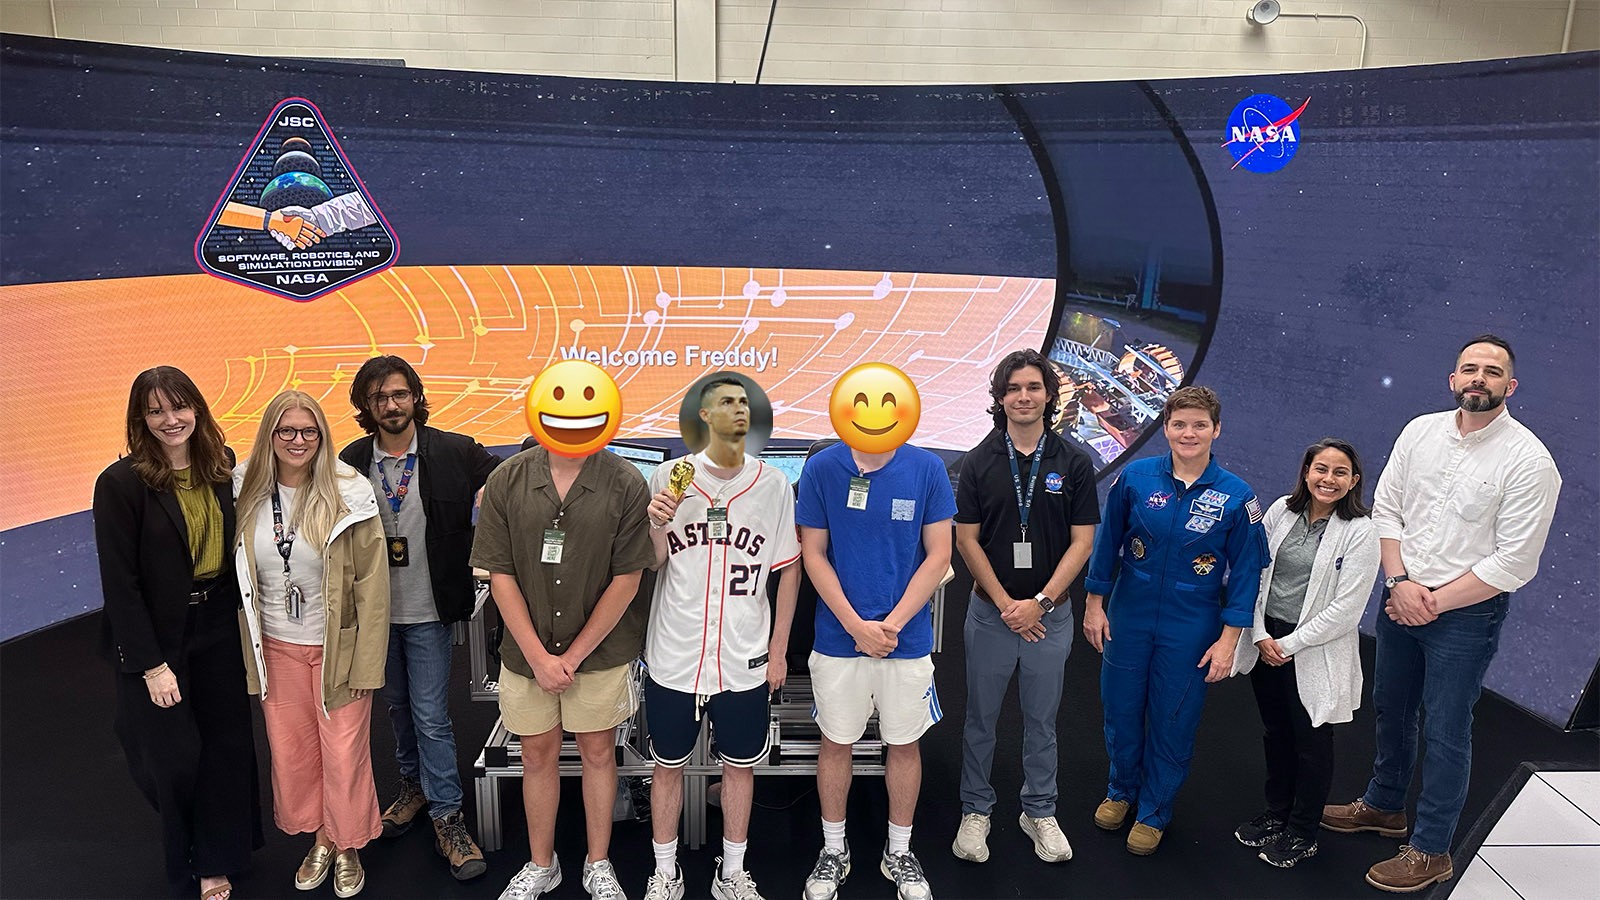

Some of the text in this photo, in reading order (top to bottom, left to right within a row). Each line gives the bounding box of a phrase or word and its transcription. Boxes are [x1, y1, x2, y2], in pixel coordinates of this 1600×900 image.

[278, 116, 314, 128] JSC
[1231, 125, 1296, 142] NASA
[218, 250, 380, 263] SOFTWARE, ROBOTICS, AND
[238, 259, 363, 270] SIMULATION DIVISION
[276, 273, 329, 285] NASA
[560, 345, 778, 372] Welcome Freddy!
[729, 563, 762, 596] 27
